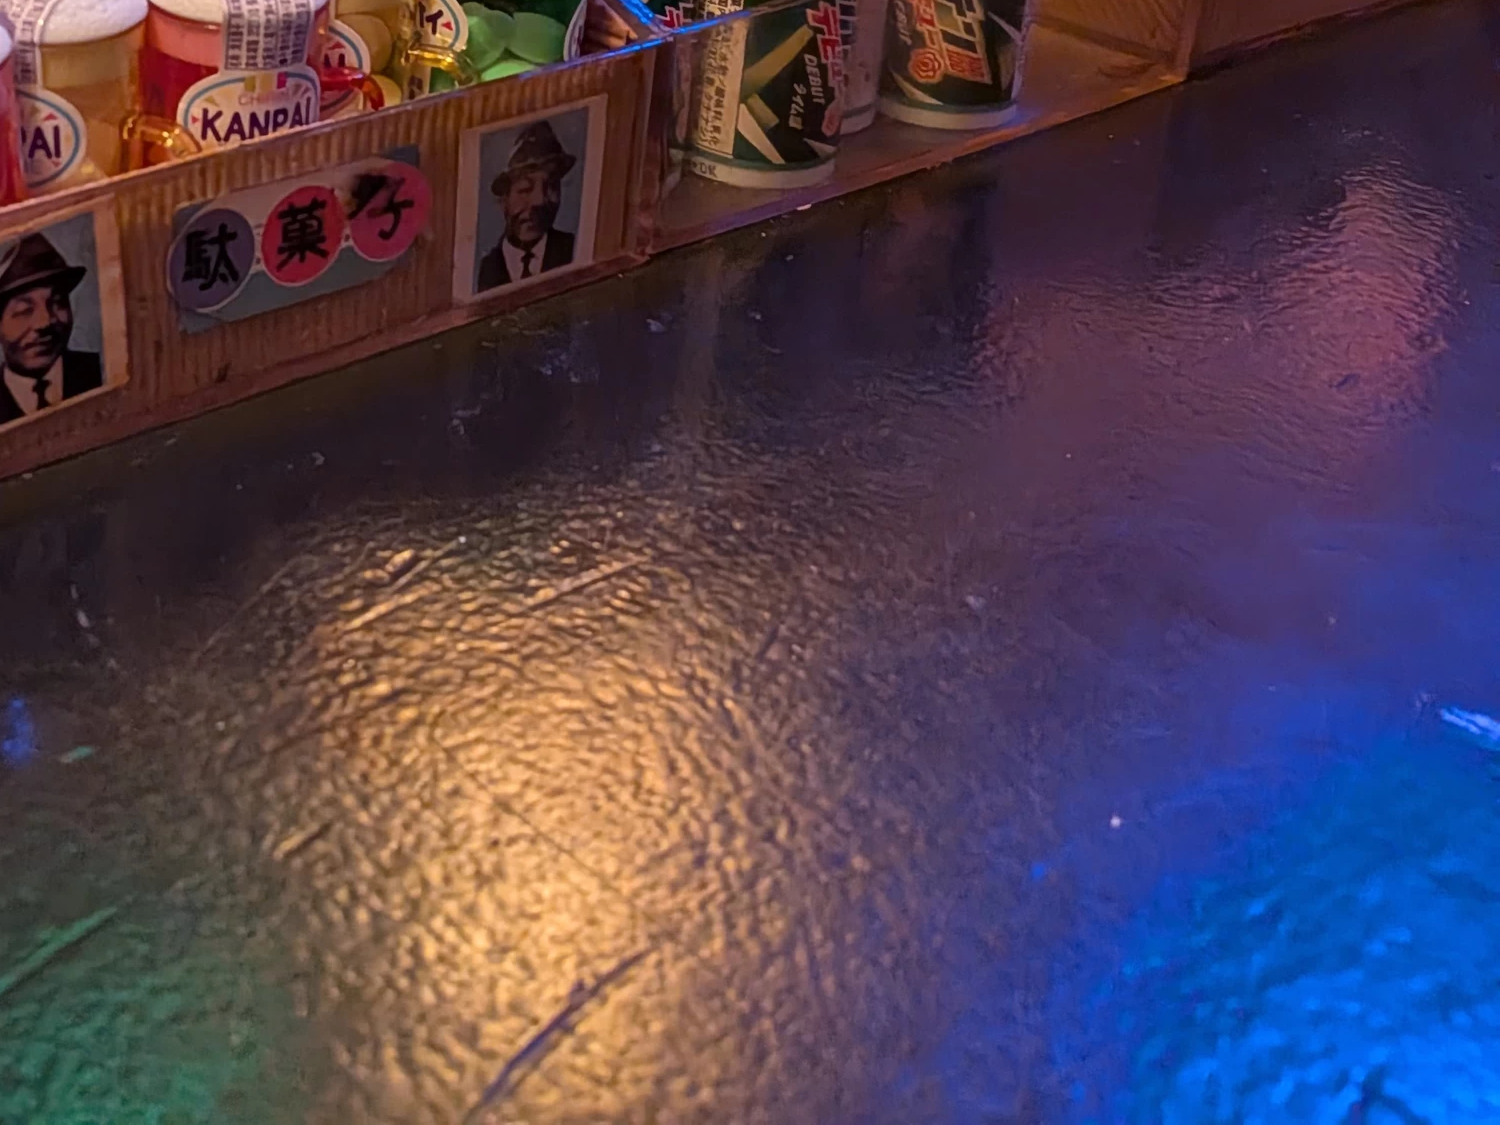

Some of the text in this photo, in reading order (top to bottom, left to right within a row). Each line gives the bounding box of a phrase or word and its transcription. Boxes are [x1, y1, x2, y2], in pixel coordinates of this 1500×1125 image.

[805, 53, 826, 105] DEBUT
[201, 96, 312, 142] KANPAI
[181, 171, 415, 292] 駄菓子
